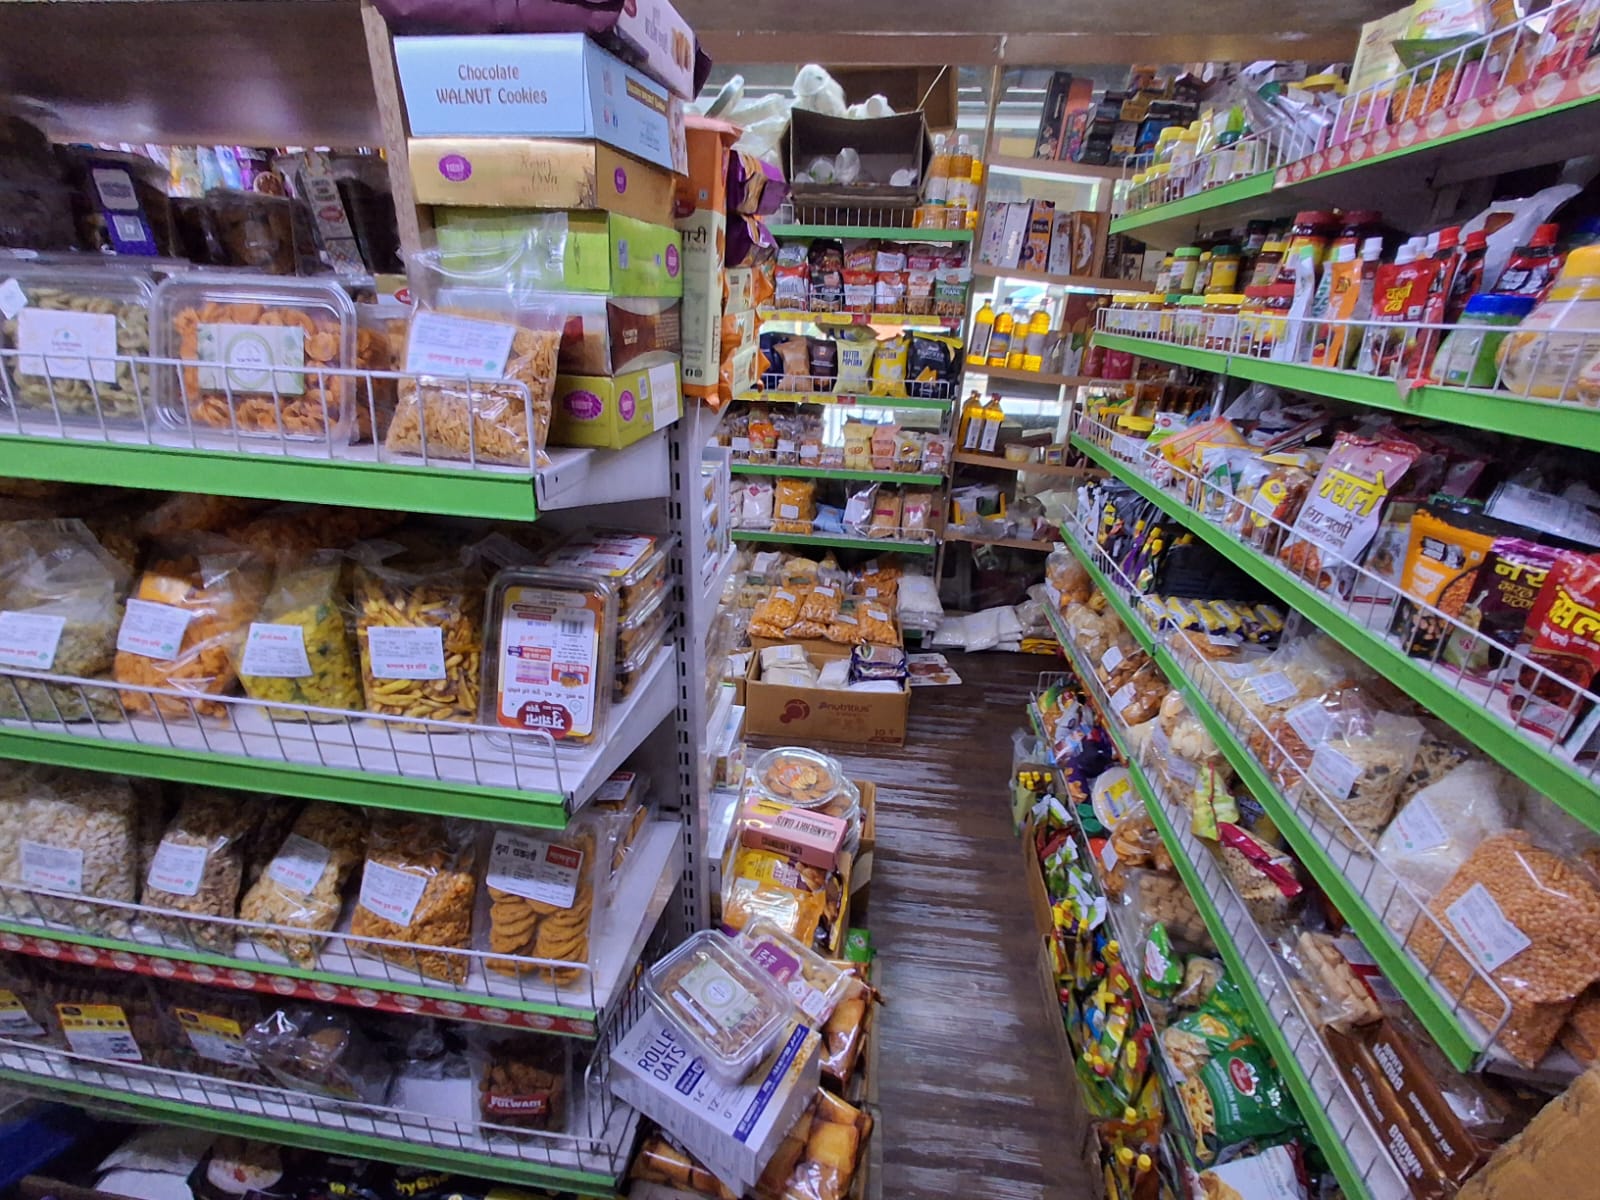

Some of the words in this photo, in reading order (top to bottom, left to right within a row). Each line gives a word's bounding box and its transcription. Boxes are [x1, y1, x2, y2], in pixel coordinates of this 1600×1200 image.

[457, 63, 520, 81] Chocolate
[436, 87, 492, 105] WALNUT
[497, 87, 548, 105] Cookies
[637, 1030, 678, 1074] ROLLE
[653, 1042, 688, 1081] OATS
[1372, 1044, 1404, 1092] BROWN
[1387, 1123, 1424, 1180] BROWN
